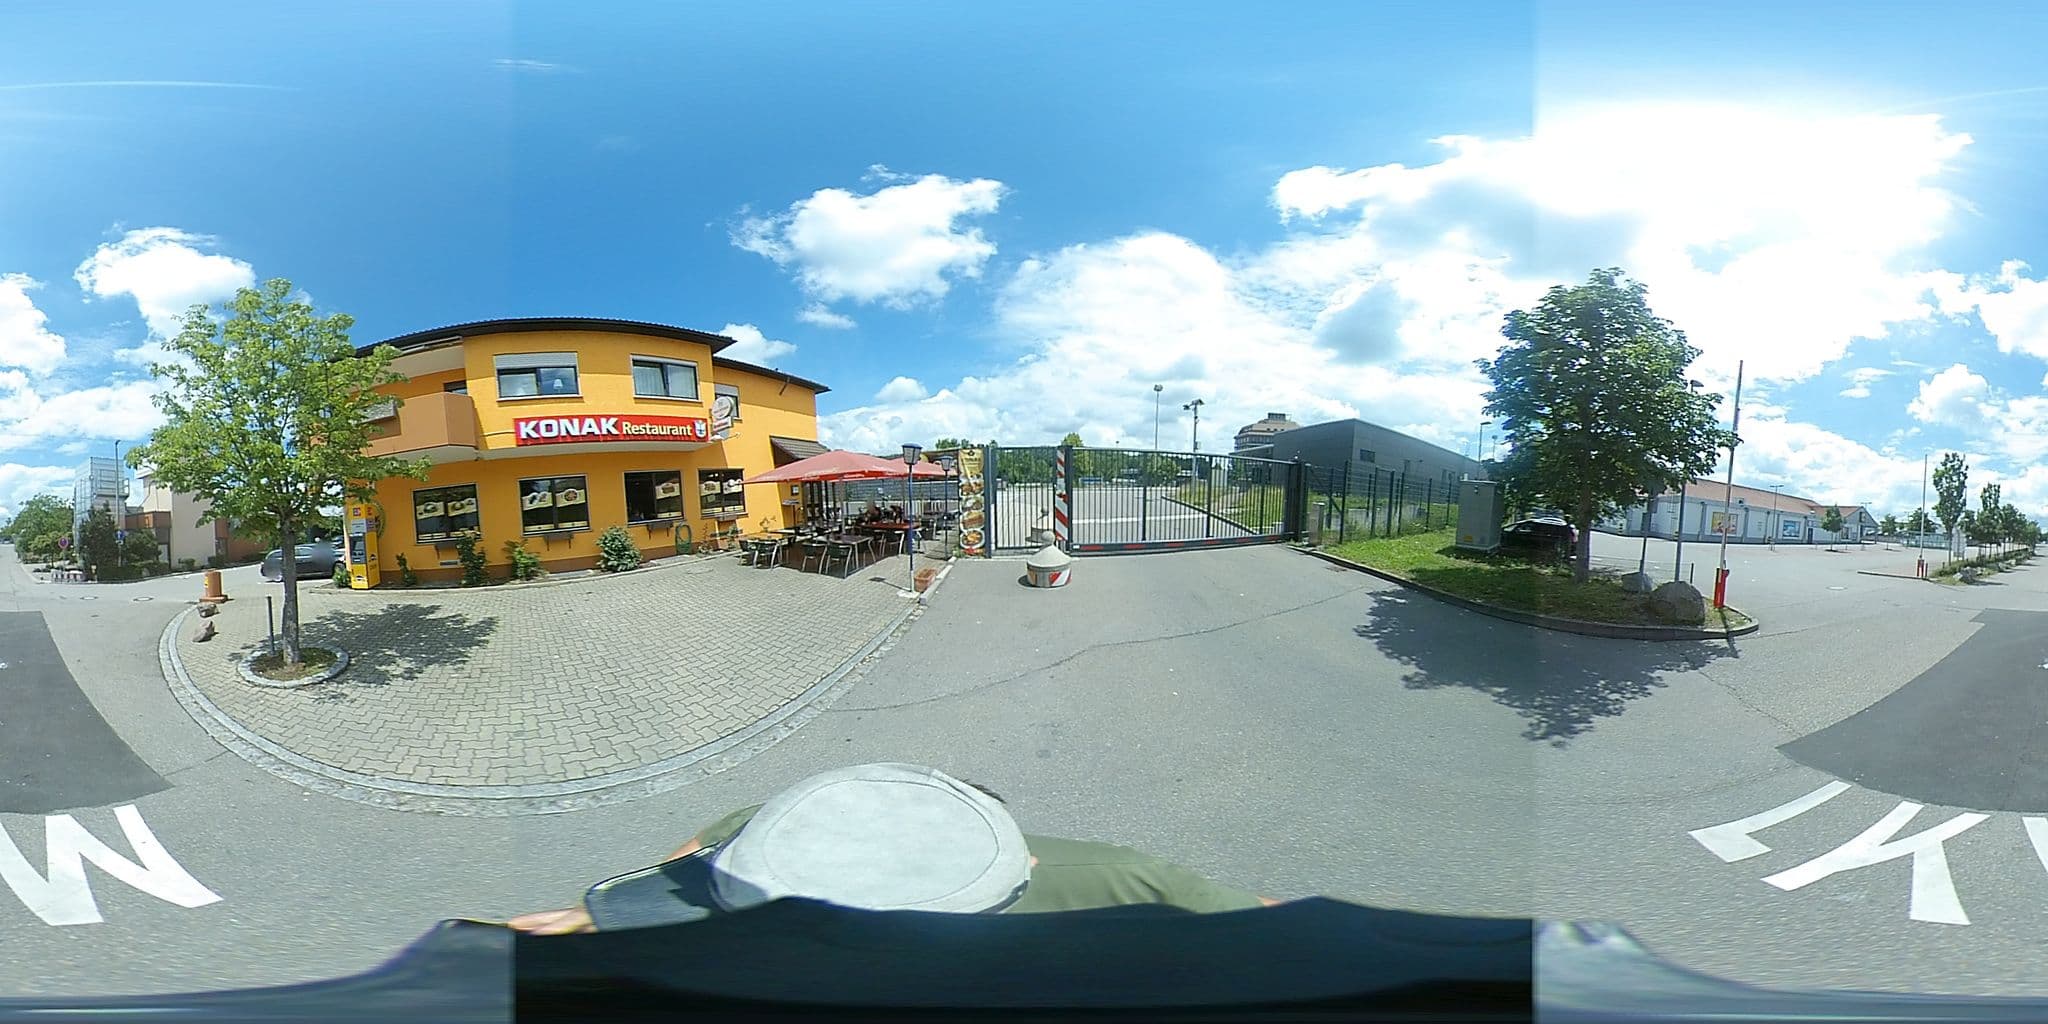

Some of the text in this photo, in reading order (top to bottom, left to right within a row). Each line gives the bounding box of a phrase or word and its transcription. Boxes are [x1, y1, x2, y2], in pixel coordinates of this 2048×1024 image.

[518, 417, 619, 439] KONAK
[622, 421, 692, 437] Restaurant
[1688, 780, 2048, 925] LK
